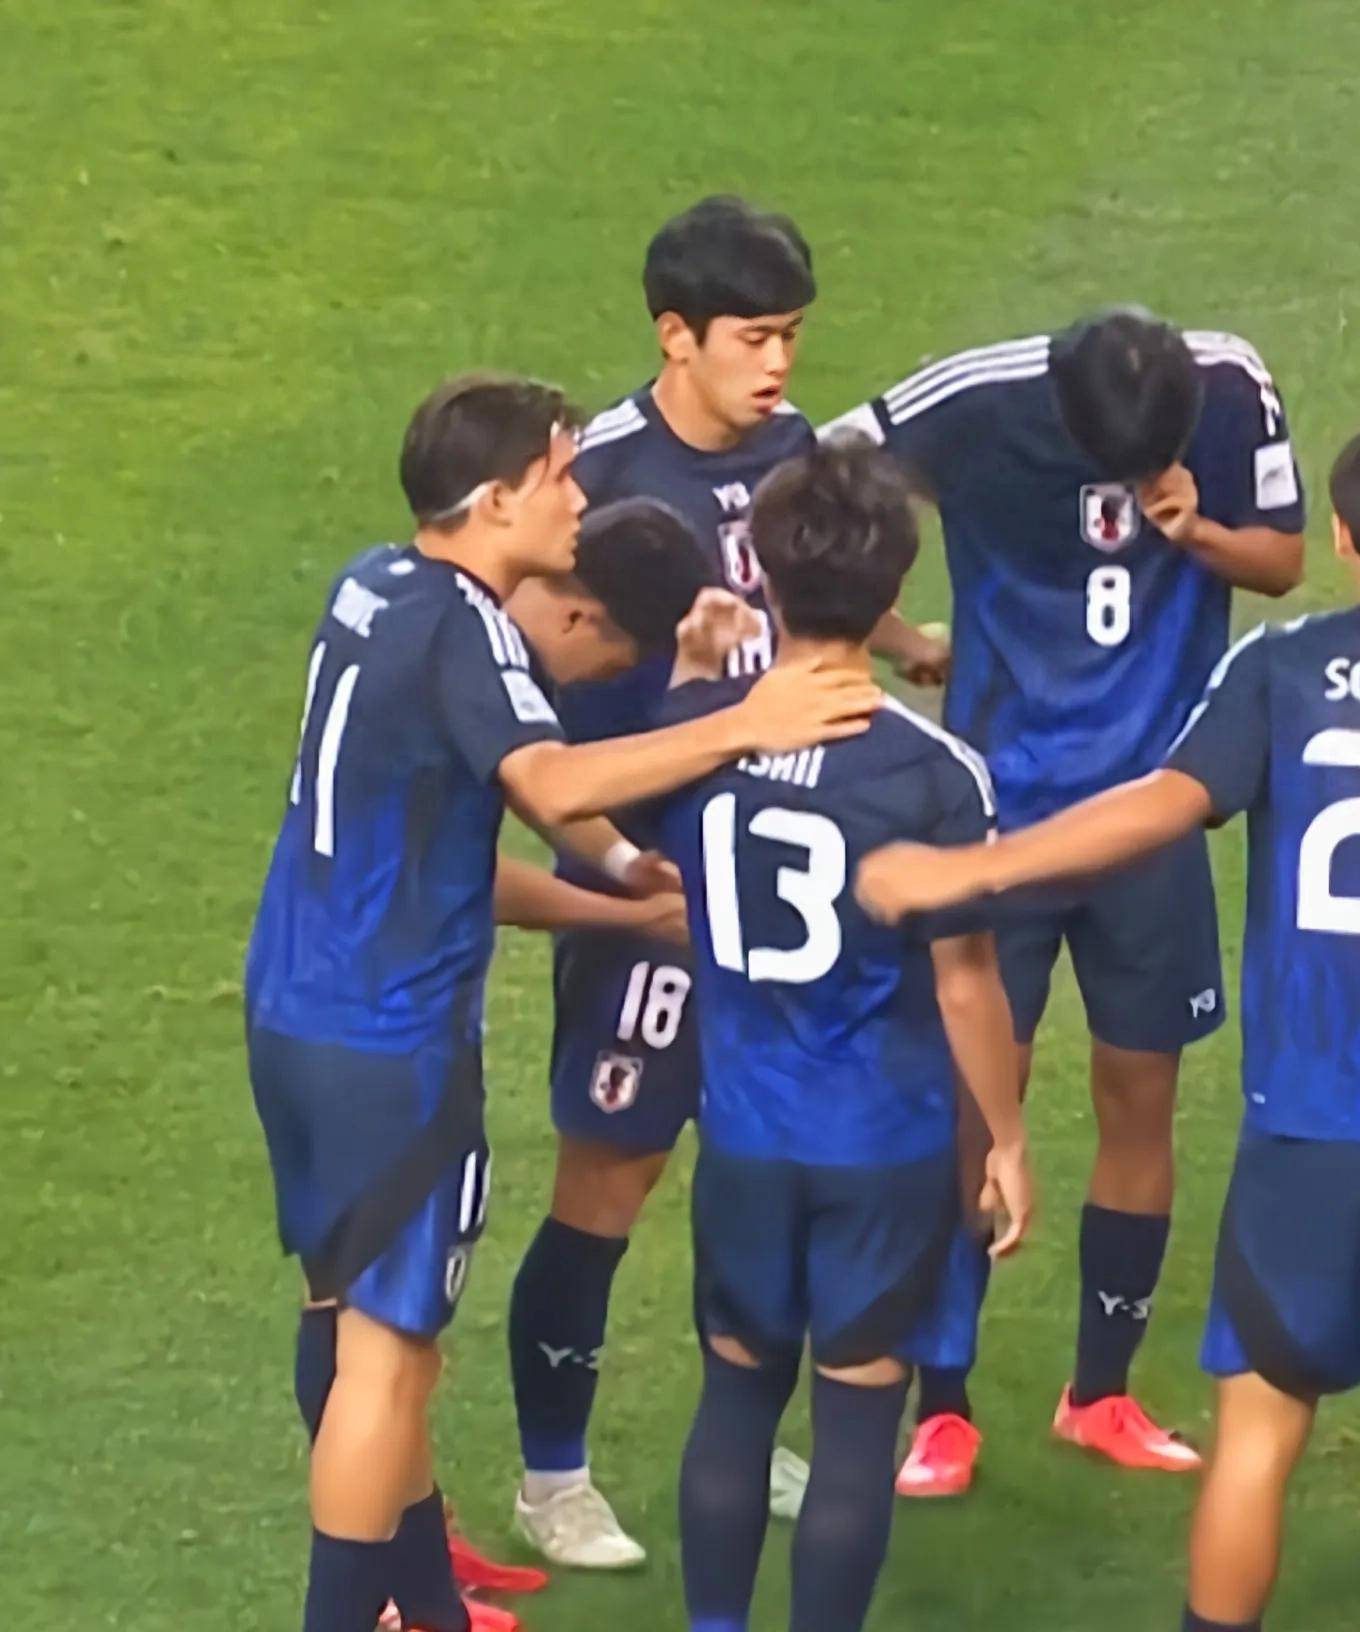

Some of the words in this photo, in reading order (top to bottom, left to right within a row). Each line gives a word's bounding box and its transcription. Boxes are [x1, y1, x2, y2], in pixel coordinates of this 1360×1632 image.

[1086, 565, 1131, 646] 8
[702, 792, 847, 984] 13
[616, 960, 692, 1049] 18
